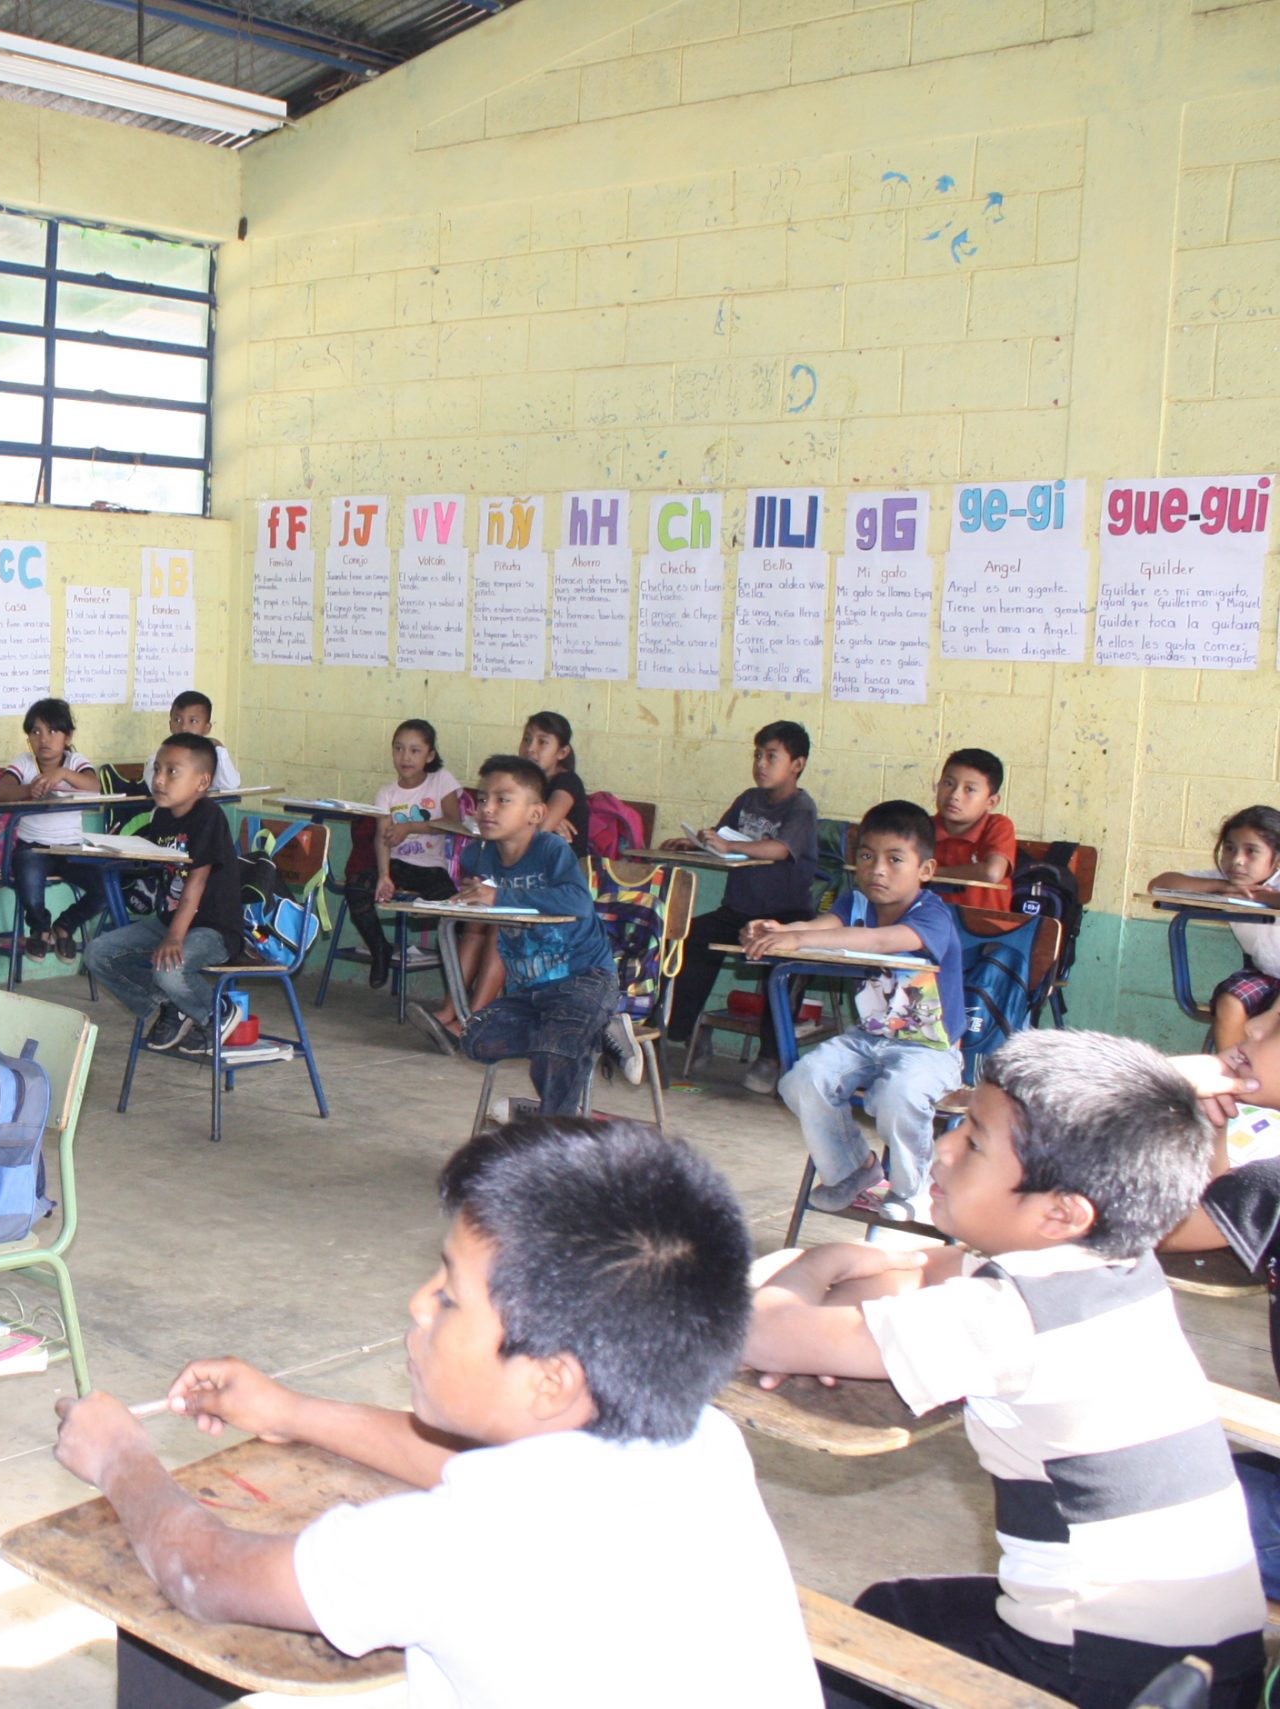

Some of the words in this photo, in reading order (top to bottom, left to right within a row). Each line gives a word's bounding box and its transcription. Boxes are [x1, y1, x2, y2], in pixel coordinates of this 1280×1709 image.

[570, 497, 619, 546] hH
[959, 479, 1066, 533] ge-gi
[1107, 476, 1271, 536] gue-gui
[763, 558, 793, 571] Bella
[881, 564, 907, 584] gato
[1140, 559, 1195, 581] Guilder
